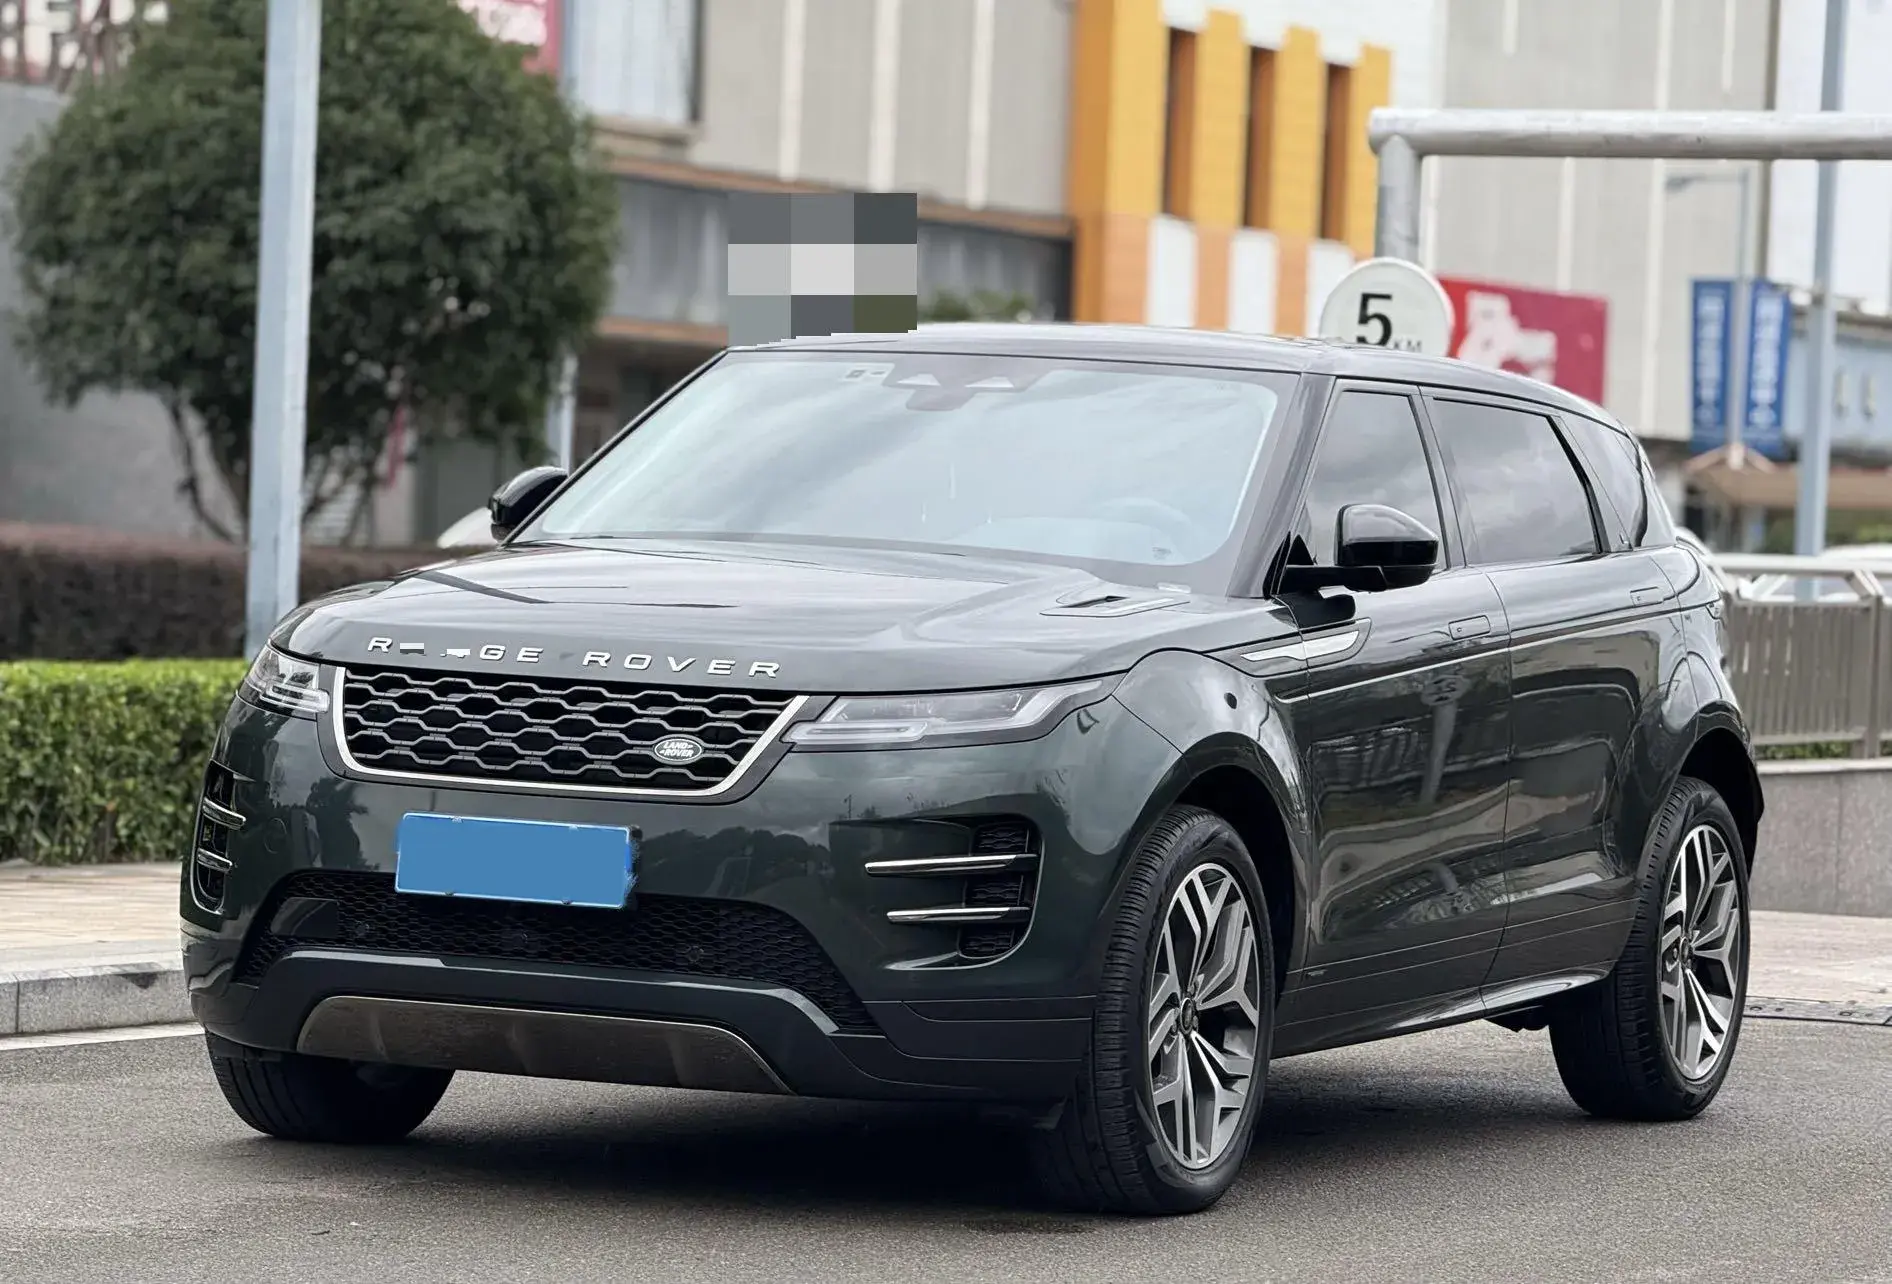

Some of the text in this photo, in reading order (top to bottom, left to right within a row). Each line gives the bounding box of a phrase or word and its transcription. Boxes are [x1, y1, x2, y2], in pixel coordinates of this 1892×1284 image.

[1356, 292, 1393, 347] 5
[367, 636, 780, 678] RGE ROVER
[663, 741, 689, 749] LAND
[663, 748, 694, 757] ROVER
